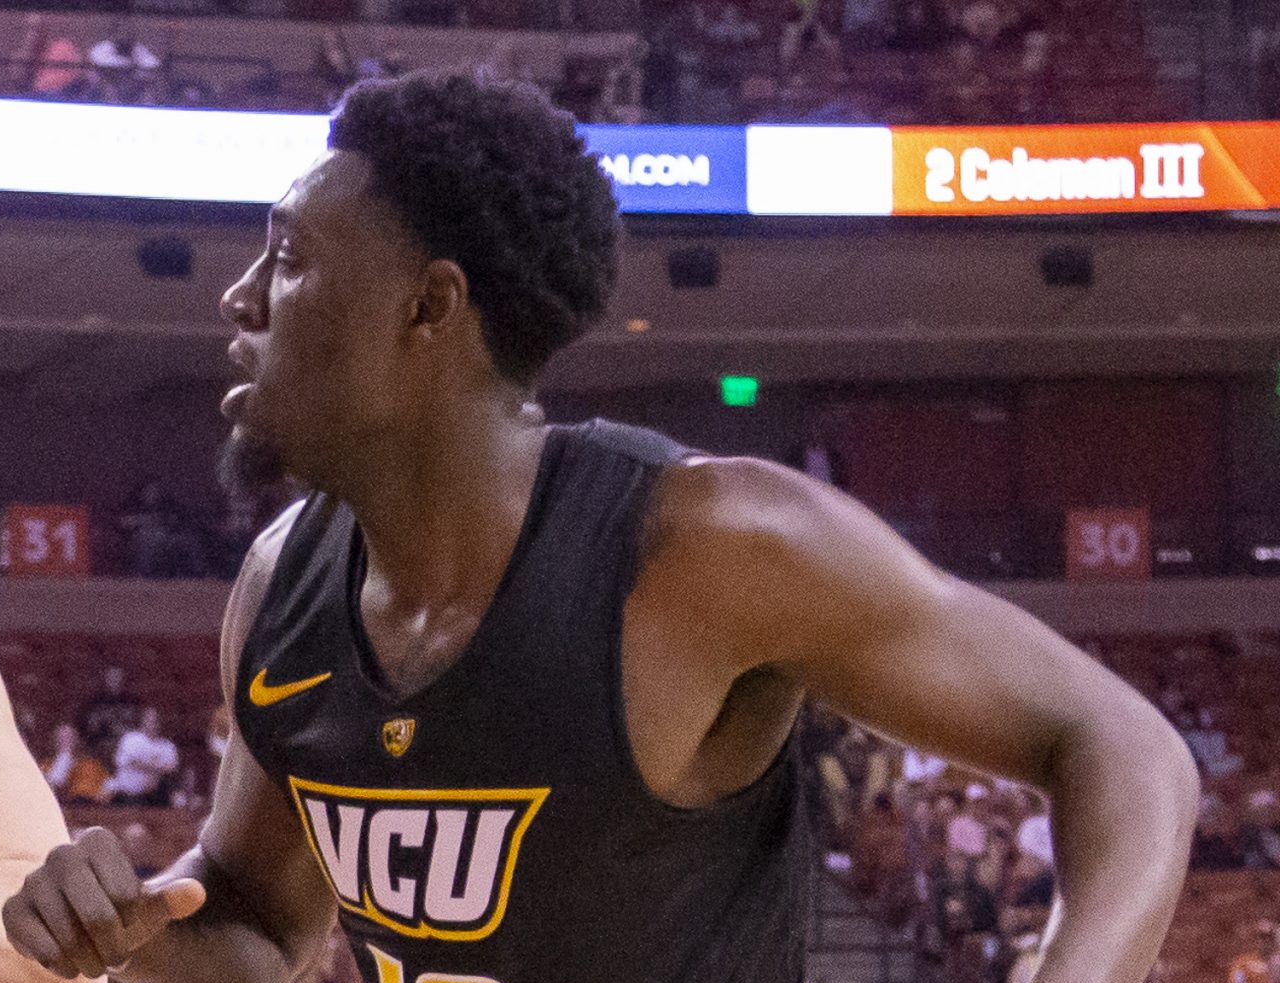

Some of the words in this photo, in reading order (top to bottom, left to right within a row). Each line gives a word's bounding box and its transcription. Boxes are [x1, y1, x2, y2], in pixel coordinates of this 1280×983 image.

[924, 146, 955, 202] 2
[960, 146, 1136, 202] Coleman
[1139, 143, 1205, 198] III
[23, 518, 77, 563] 31
[1081, 522, 1140, 566] 30
[305, 799, 516, 922] VCU
